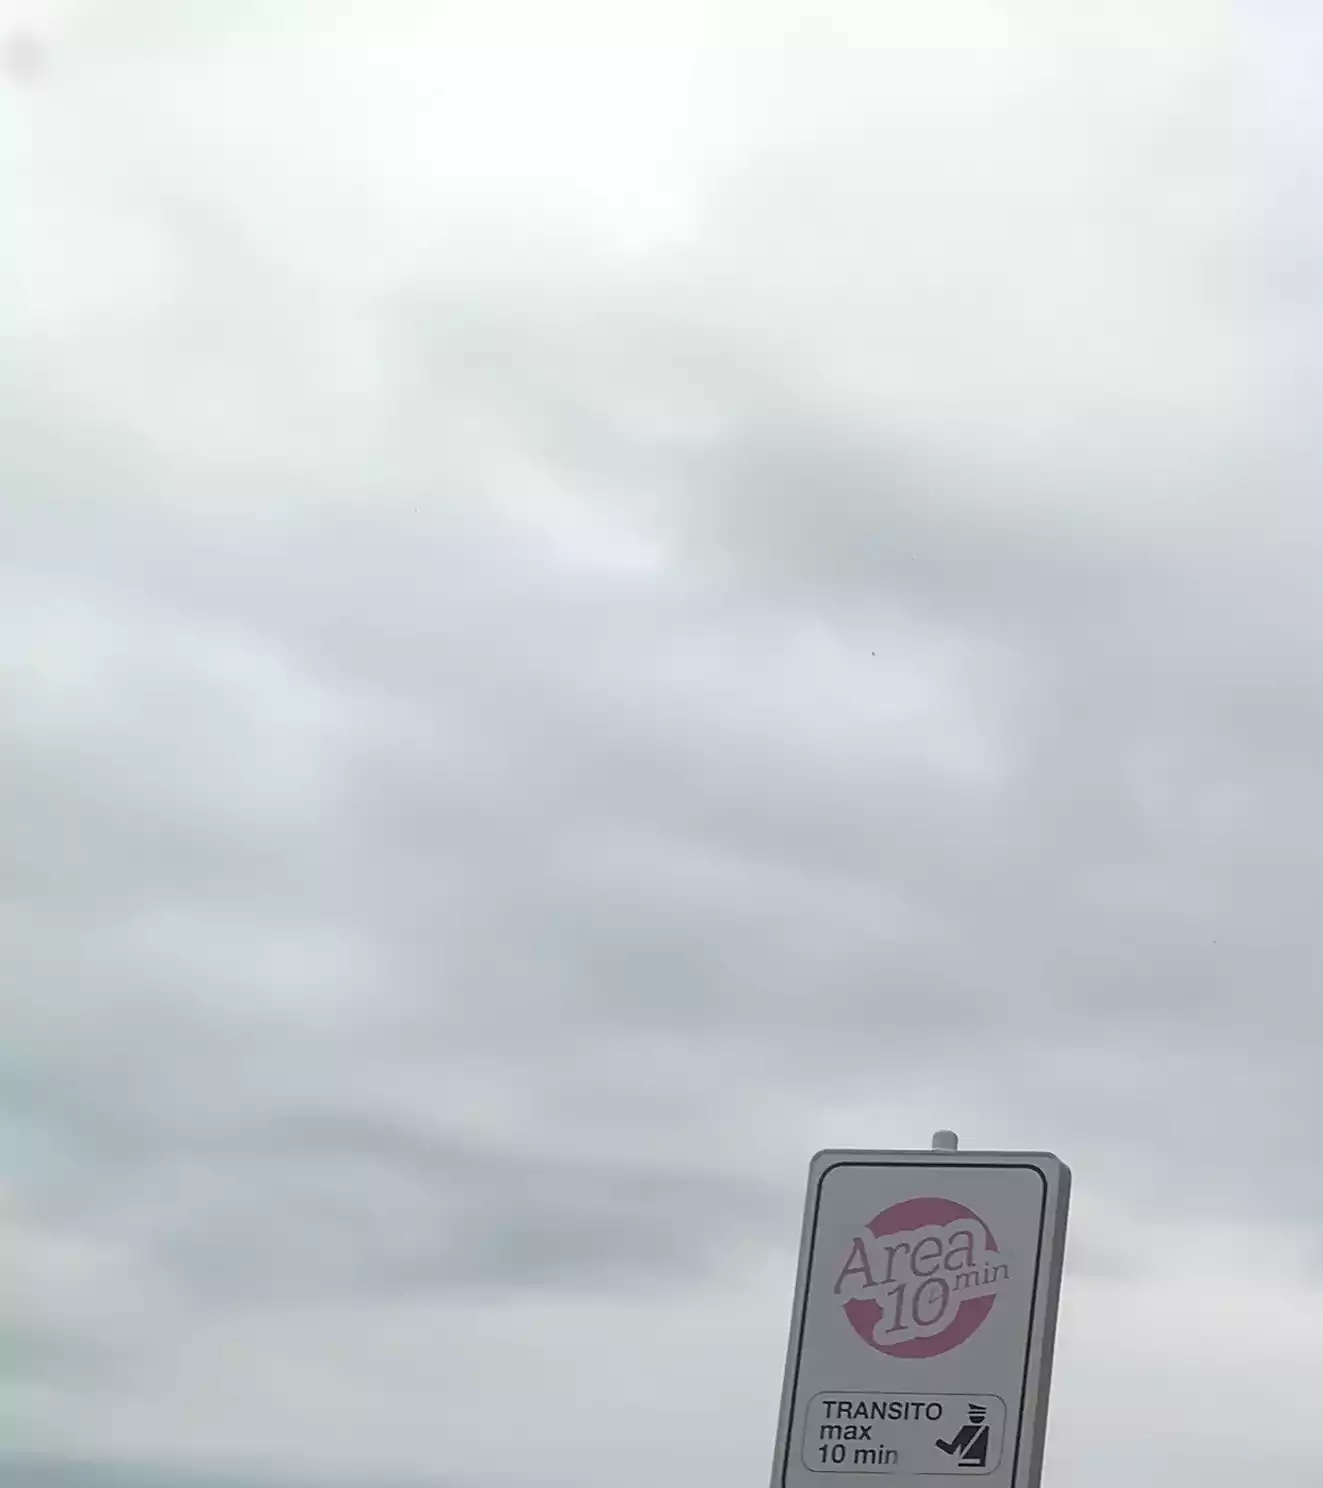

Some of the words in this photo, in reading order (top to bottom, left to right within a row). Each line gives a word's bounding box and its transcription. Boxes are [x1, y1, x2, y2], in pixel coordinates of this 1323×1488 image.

[834, 1230, 976, 1295] Area
[885, 1277, 950, 1334] 10
[953, 1264, 1010, 1292] min
[822, 1401, 943, 1420] TRANSITO
[820, 1425, 872, 1440] max
[819, 1444, 846, 1464] 10
[853, 1445, 898, 1465] min
